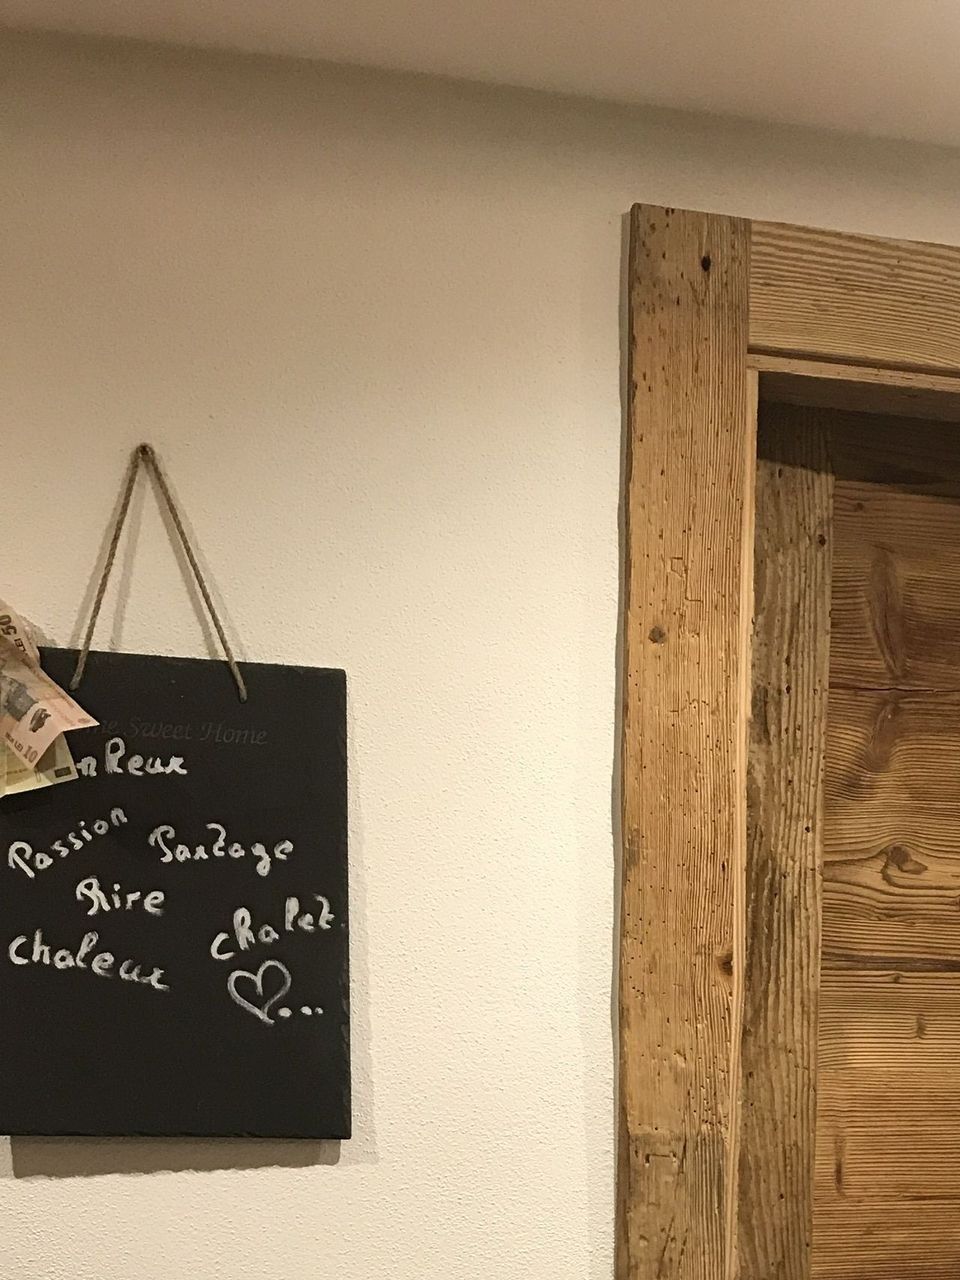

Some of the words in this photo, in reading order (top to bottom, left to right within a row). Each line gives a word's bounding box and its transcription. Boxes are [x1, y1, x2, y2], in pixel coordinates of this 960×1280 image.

[124, 715, 192, 740] Sweet
[200, 720, 269, 745] Home
[23, 746, 39, 764] 10
[8, 807, 128, 878] Passion
[149, 822, 294, 877] Partage
[76, 876, 165, 916] Rire
